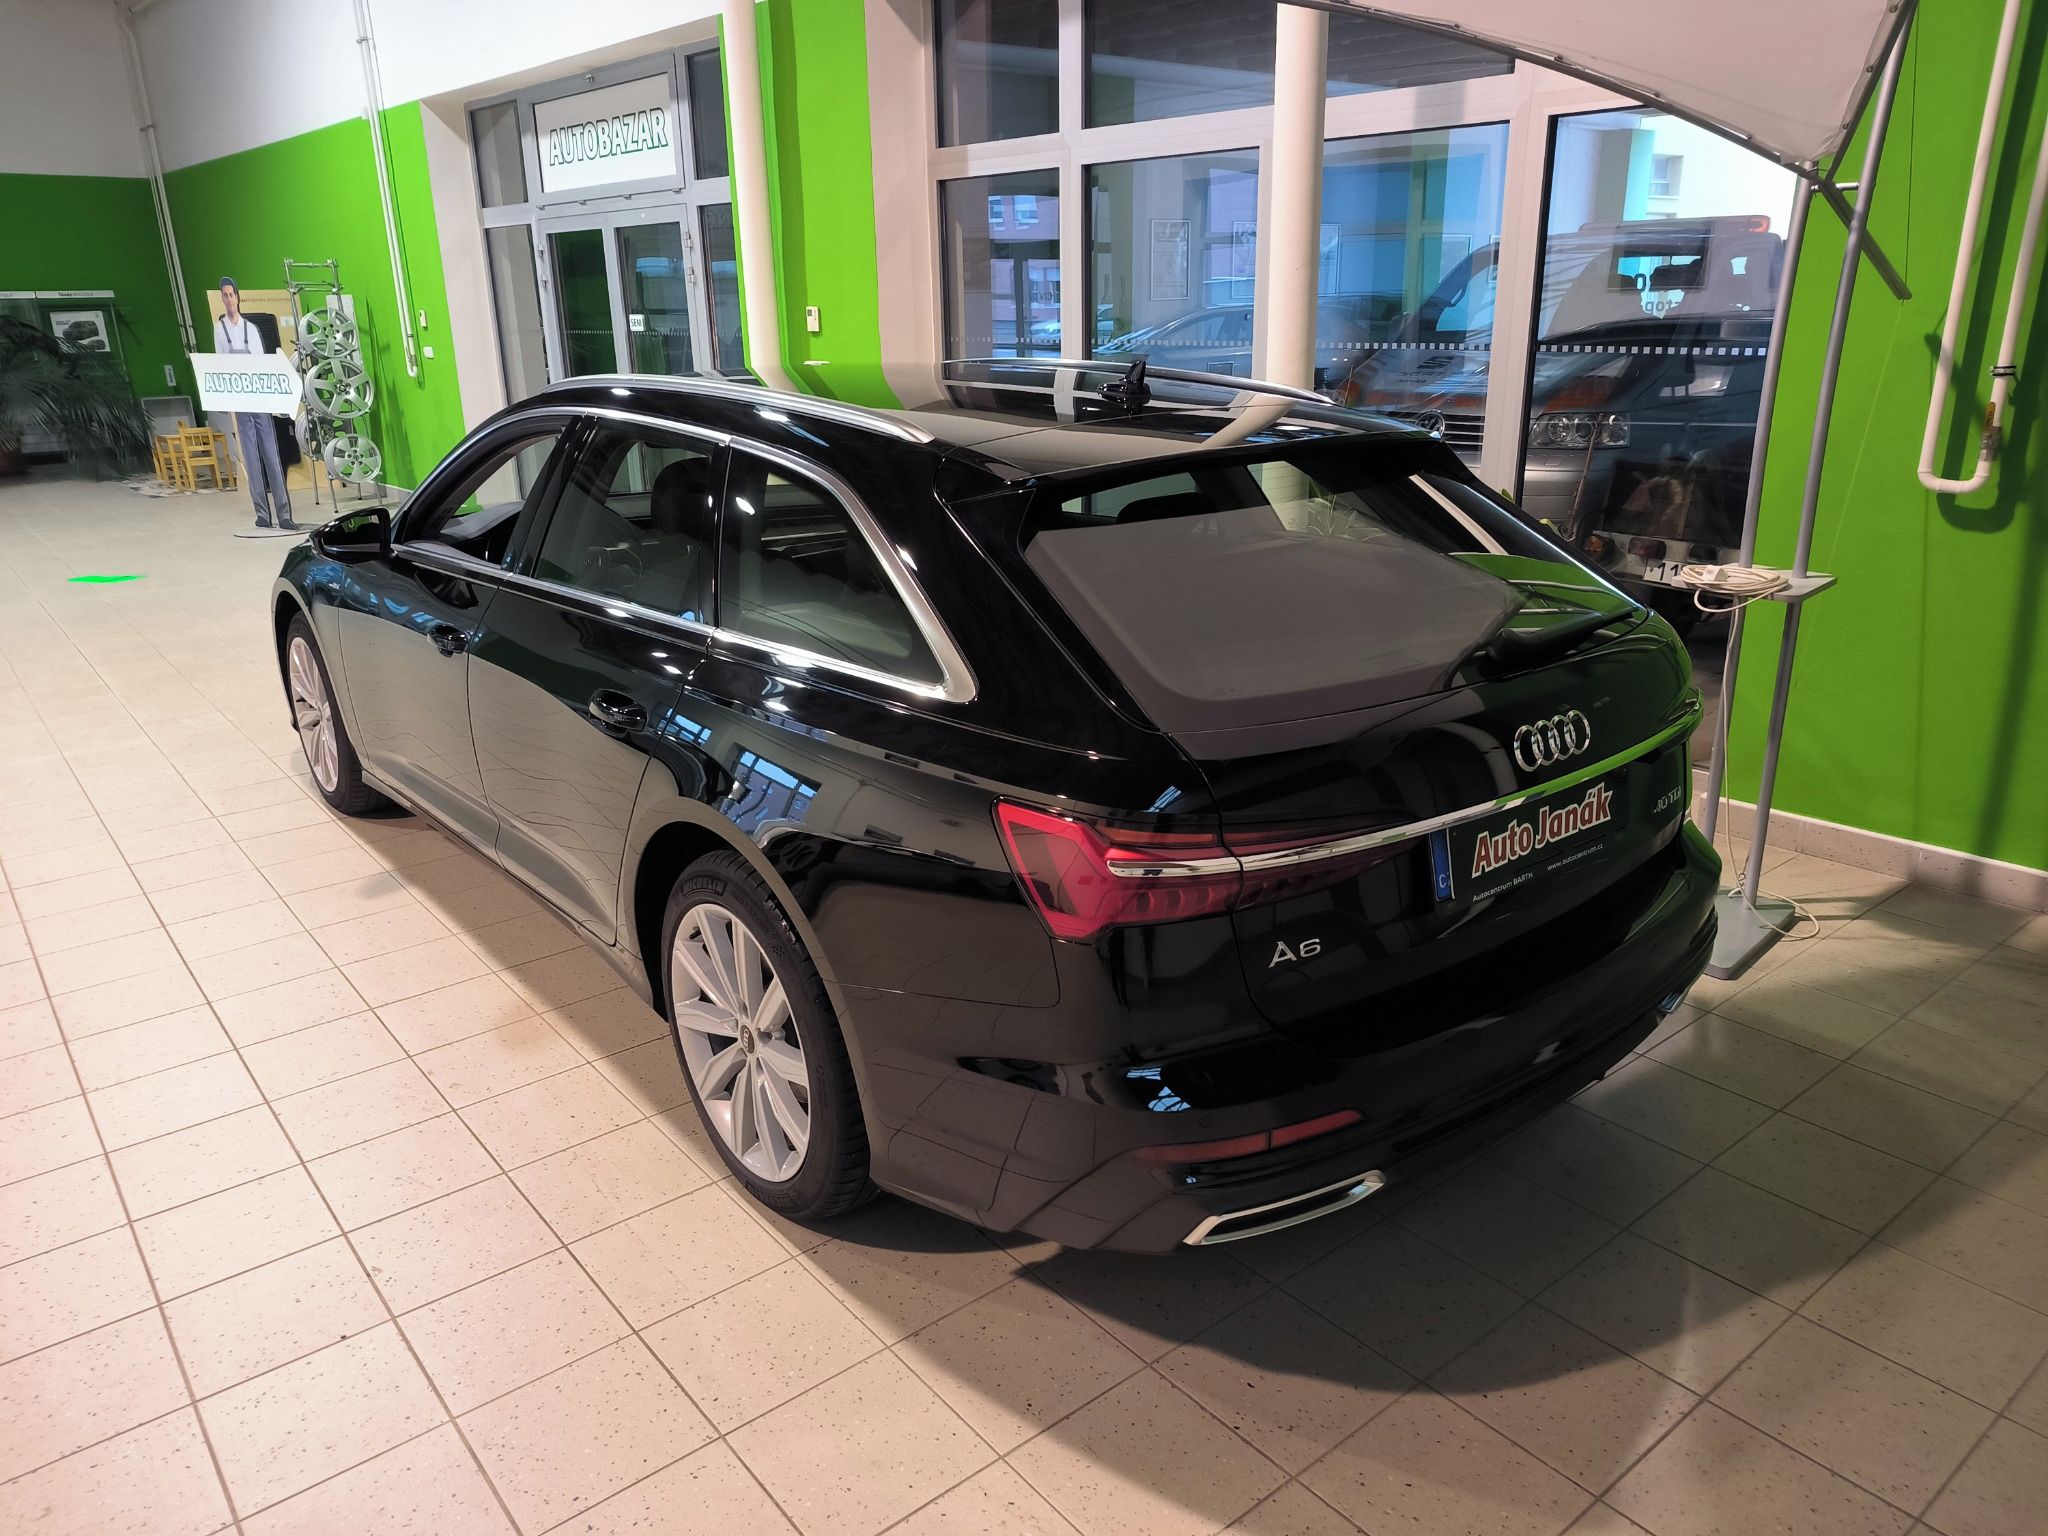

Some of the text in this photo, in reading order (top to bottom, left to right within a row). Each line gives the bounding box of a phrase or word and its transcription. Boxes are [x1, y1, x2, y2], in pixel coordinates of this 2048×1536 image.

[550, 107, 668, 166] AUTOBAZAR
[205, 372, 292, 394] AUTOBAZAR
[1472, 782, 1613, 878] Auto Janák
[1473, 872, 1534, 902] Autocentrum BARTH
[1268, 938, 1321, 969] A6
